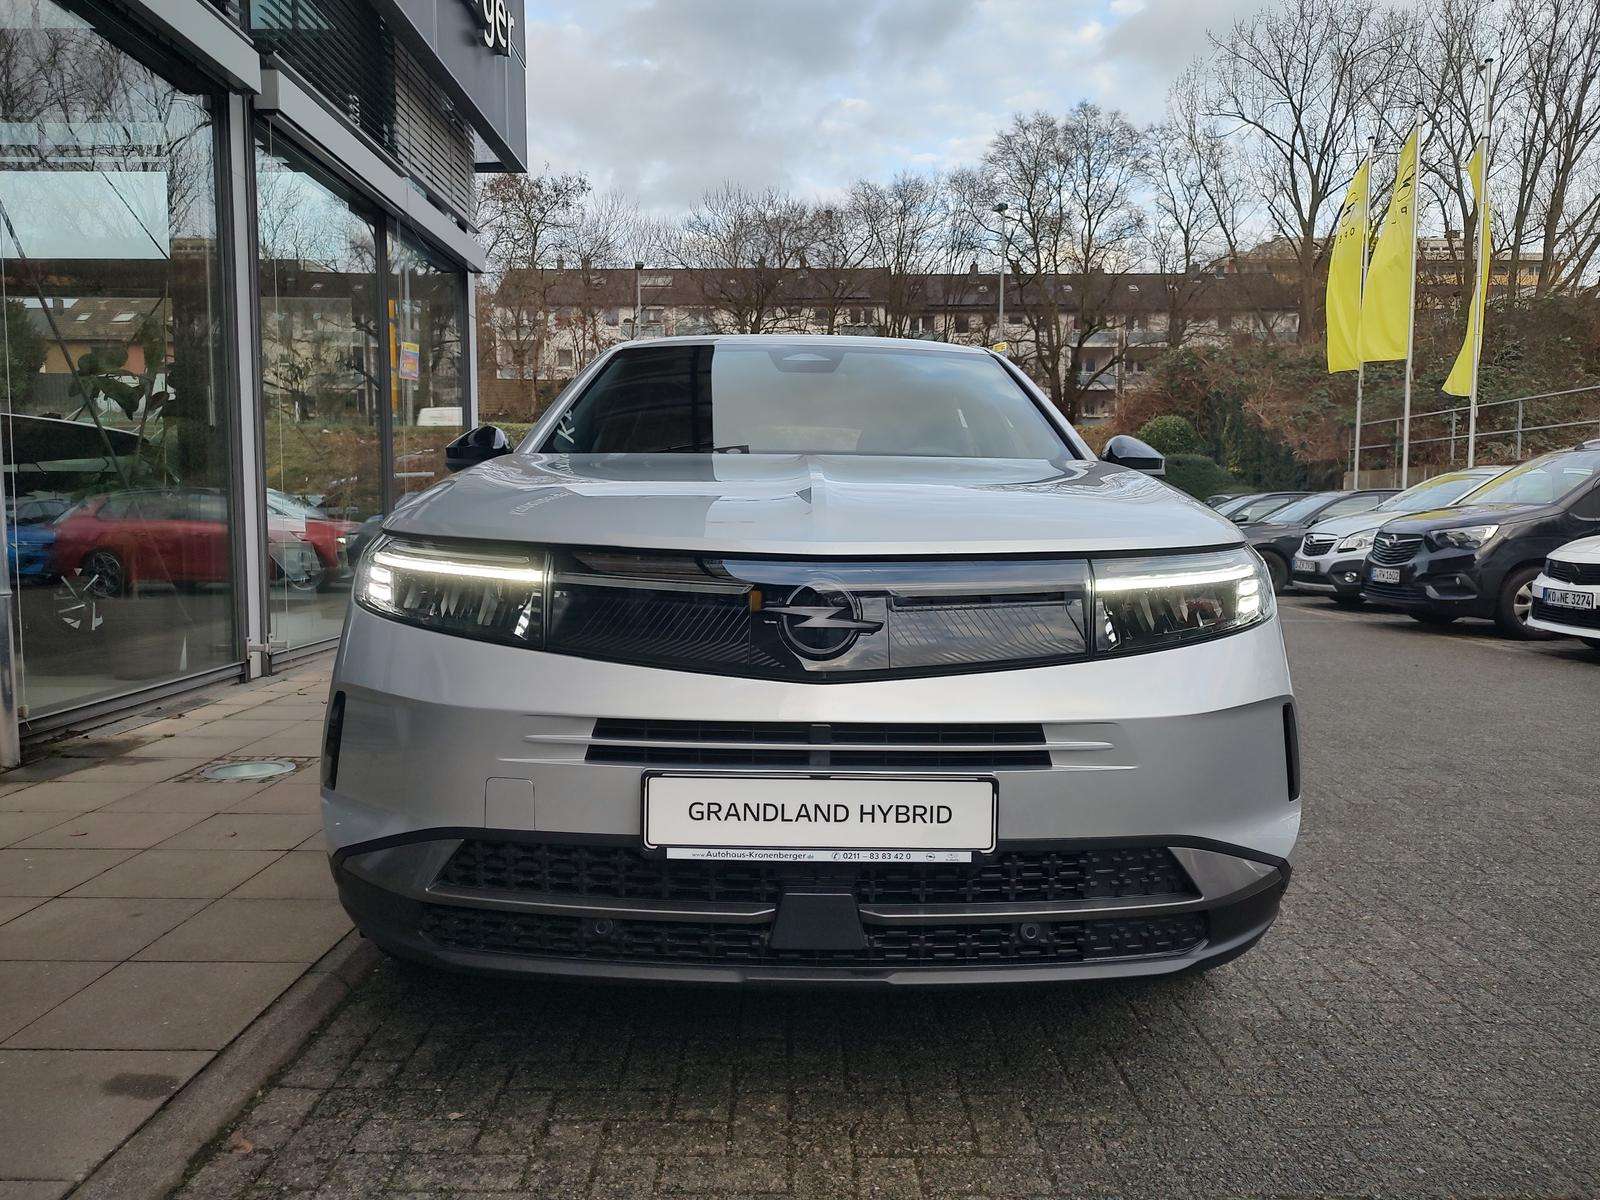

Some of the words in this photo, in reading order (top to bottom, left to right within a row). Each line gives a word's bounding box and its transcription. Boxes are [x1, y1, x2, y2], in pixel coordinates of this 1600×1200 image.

[474, 0, 515, 57] ger
[1571, 593, 1591, 607] 3274
[688, 802, 849, 822] GRANDLAND
[860, 804, 953, 824] HYBRID
[842, 852, 860, 860] 0211
[869, 852, 879, 861] 83
[881, 852, 892, 861] 83
[893, 853, 904, 861] 42
[905, 853, 911, 861] 0
